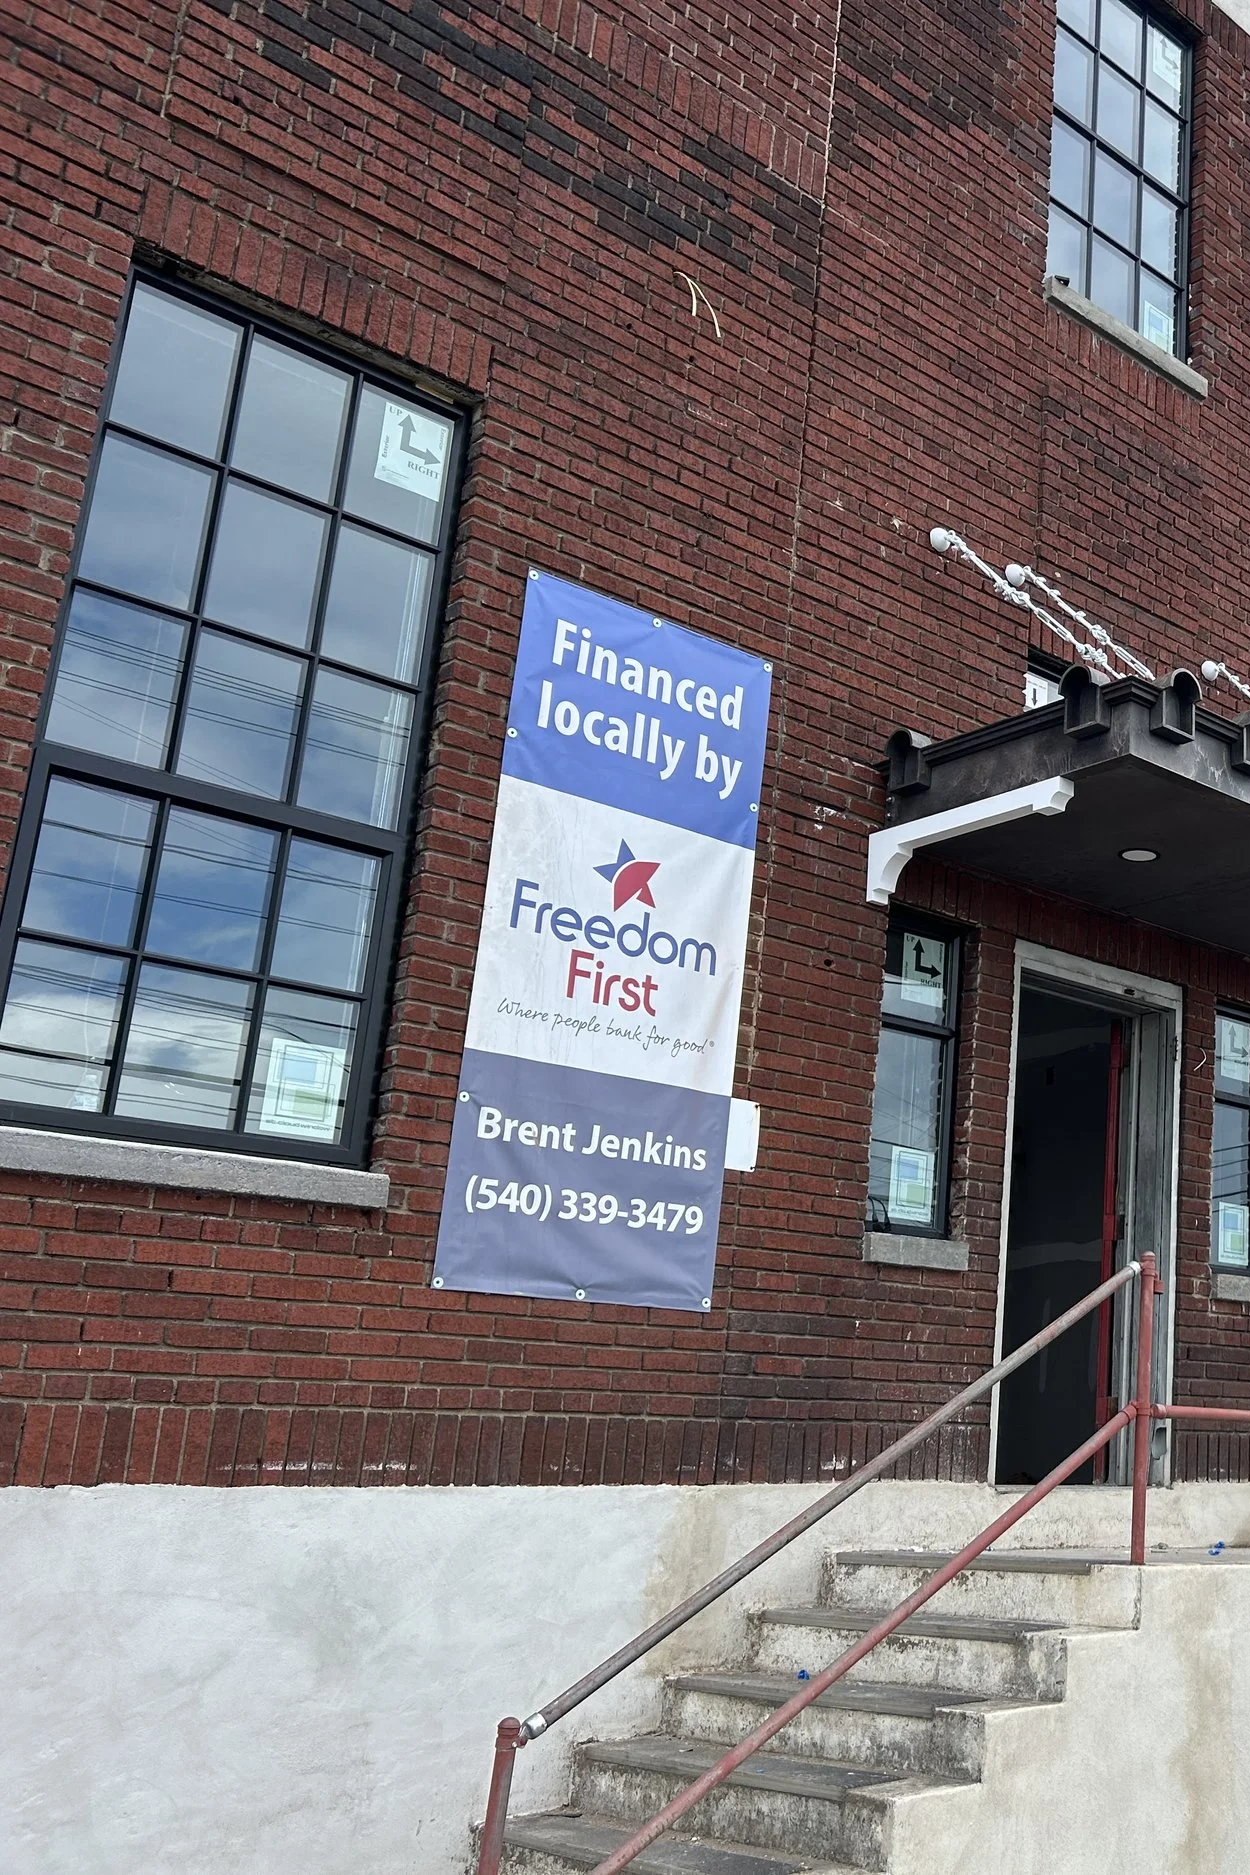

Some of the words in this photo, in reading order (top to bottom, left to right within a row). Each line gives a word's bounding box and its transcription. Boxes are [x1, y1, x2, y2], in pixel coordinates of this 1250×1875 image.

[389, 406, 403, 416] UP
[407, 461, 441, 480] RIGHT
[552, 618, 744, 730] Financed
[537, 680, 686, 781] locally
[694, 734, 743, 800] by
[509, 878, 717, 976] Freedom
[566, 949, 659, 1017] First
[497, 998, 549, 1022] Where
[552, 1013, 601, 1037] people
[606, 1018, 643, 1041] bank
[642, 1025, 670, 1051] for
[476, 1106, 576, 1152] Brent
[581, 1125, 707, 1171] Jenkins
[465, 1175, 552, 1222] (540)
[557, 1189, 704, 1235] 339-3479
